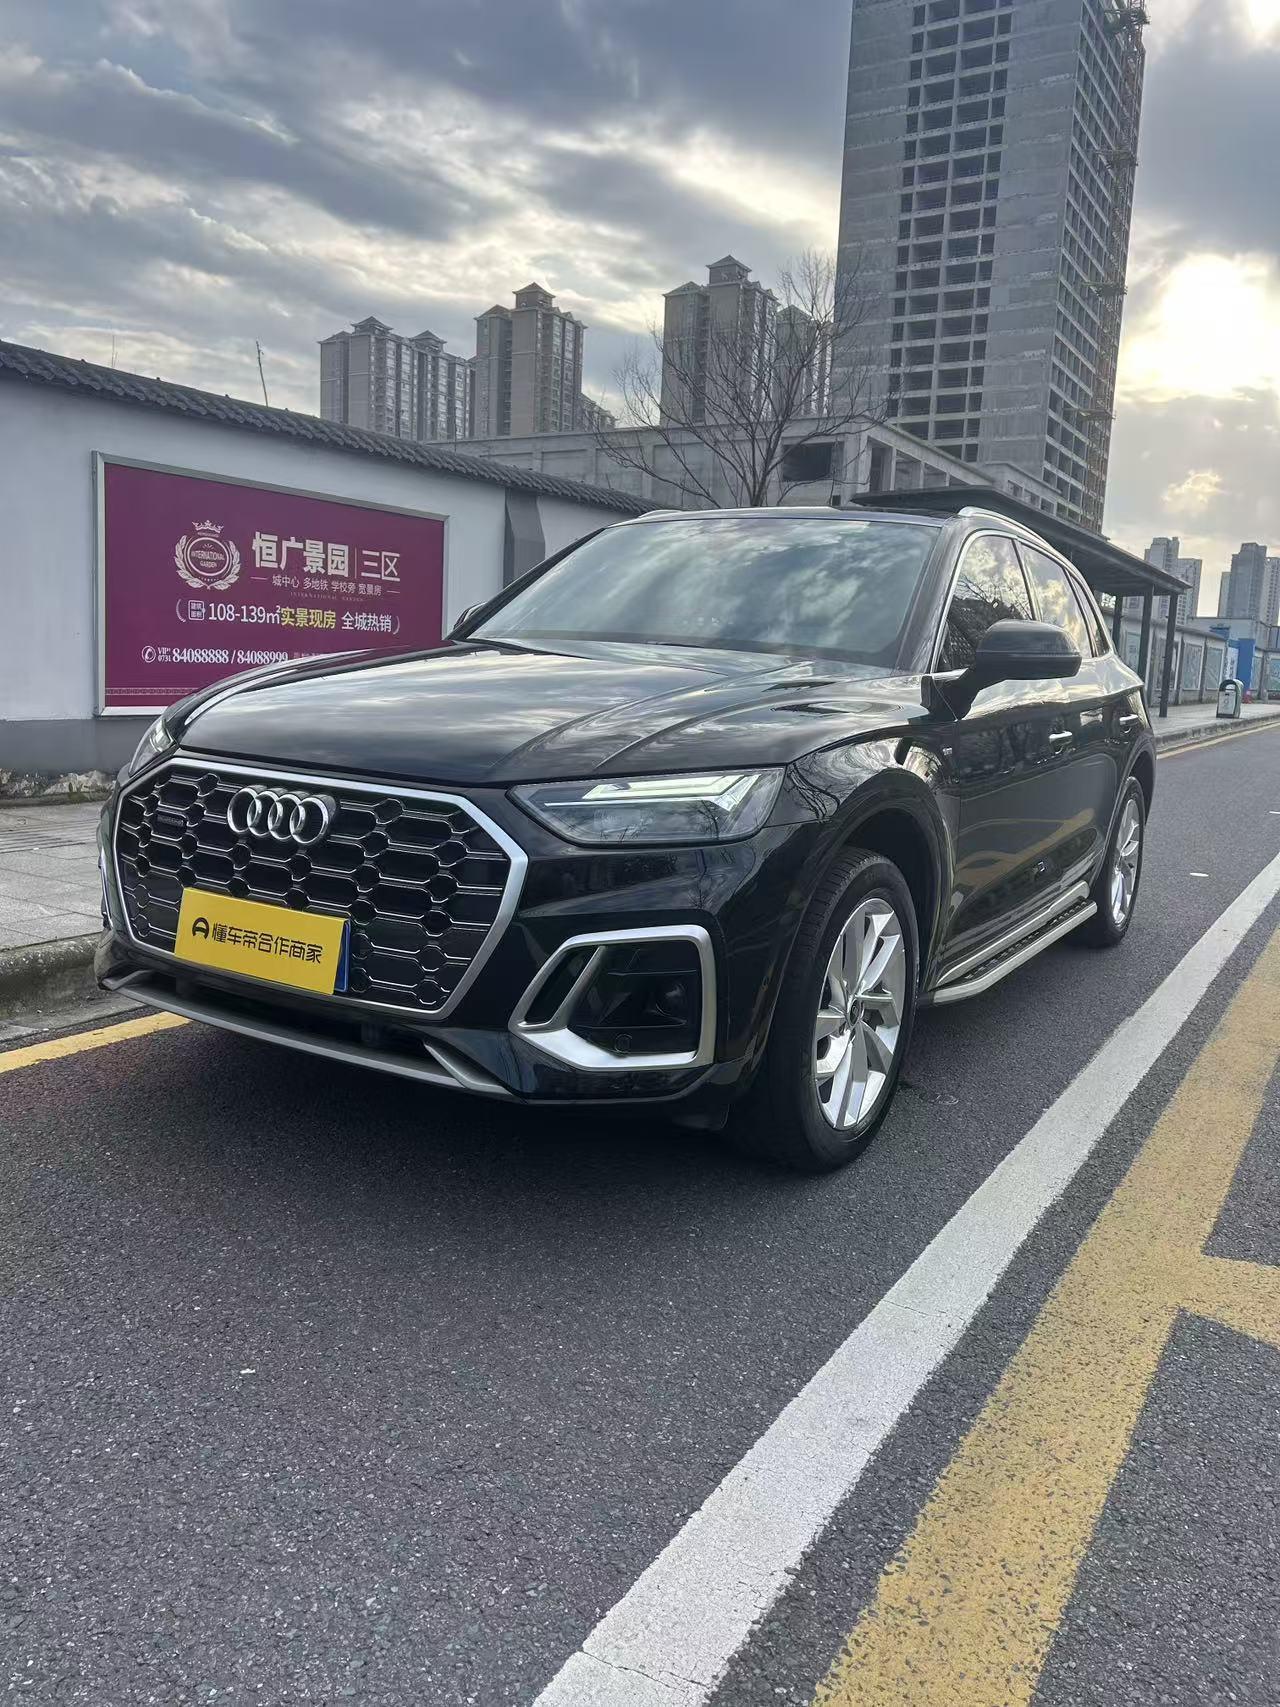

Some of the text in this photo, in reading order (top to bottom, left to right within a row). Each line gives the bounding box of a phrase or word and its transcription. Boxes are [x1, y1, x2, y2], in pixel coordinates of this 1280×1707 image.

[252, 531, 400, 582] 恒广景园 三区
[272, 574, 299, 588] 城中心
[303, 577, 328, 591] 多地铁
[331, 580, 355, 594] 学校旁
[281, 606, 336, 629] 实景现房
[341, 611, 392, 633] 全城热销
[172, 647, 229, 664] 84088888
[236, 649, 288, 664] 84088999
[212, 922, 323, 964] 懂车帝合作商家
